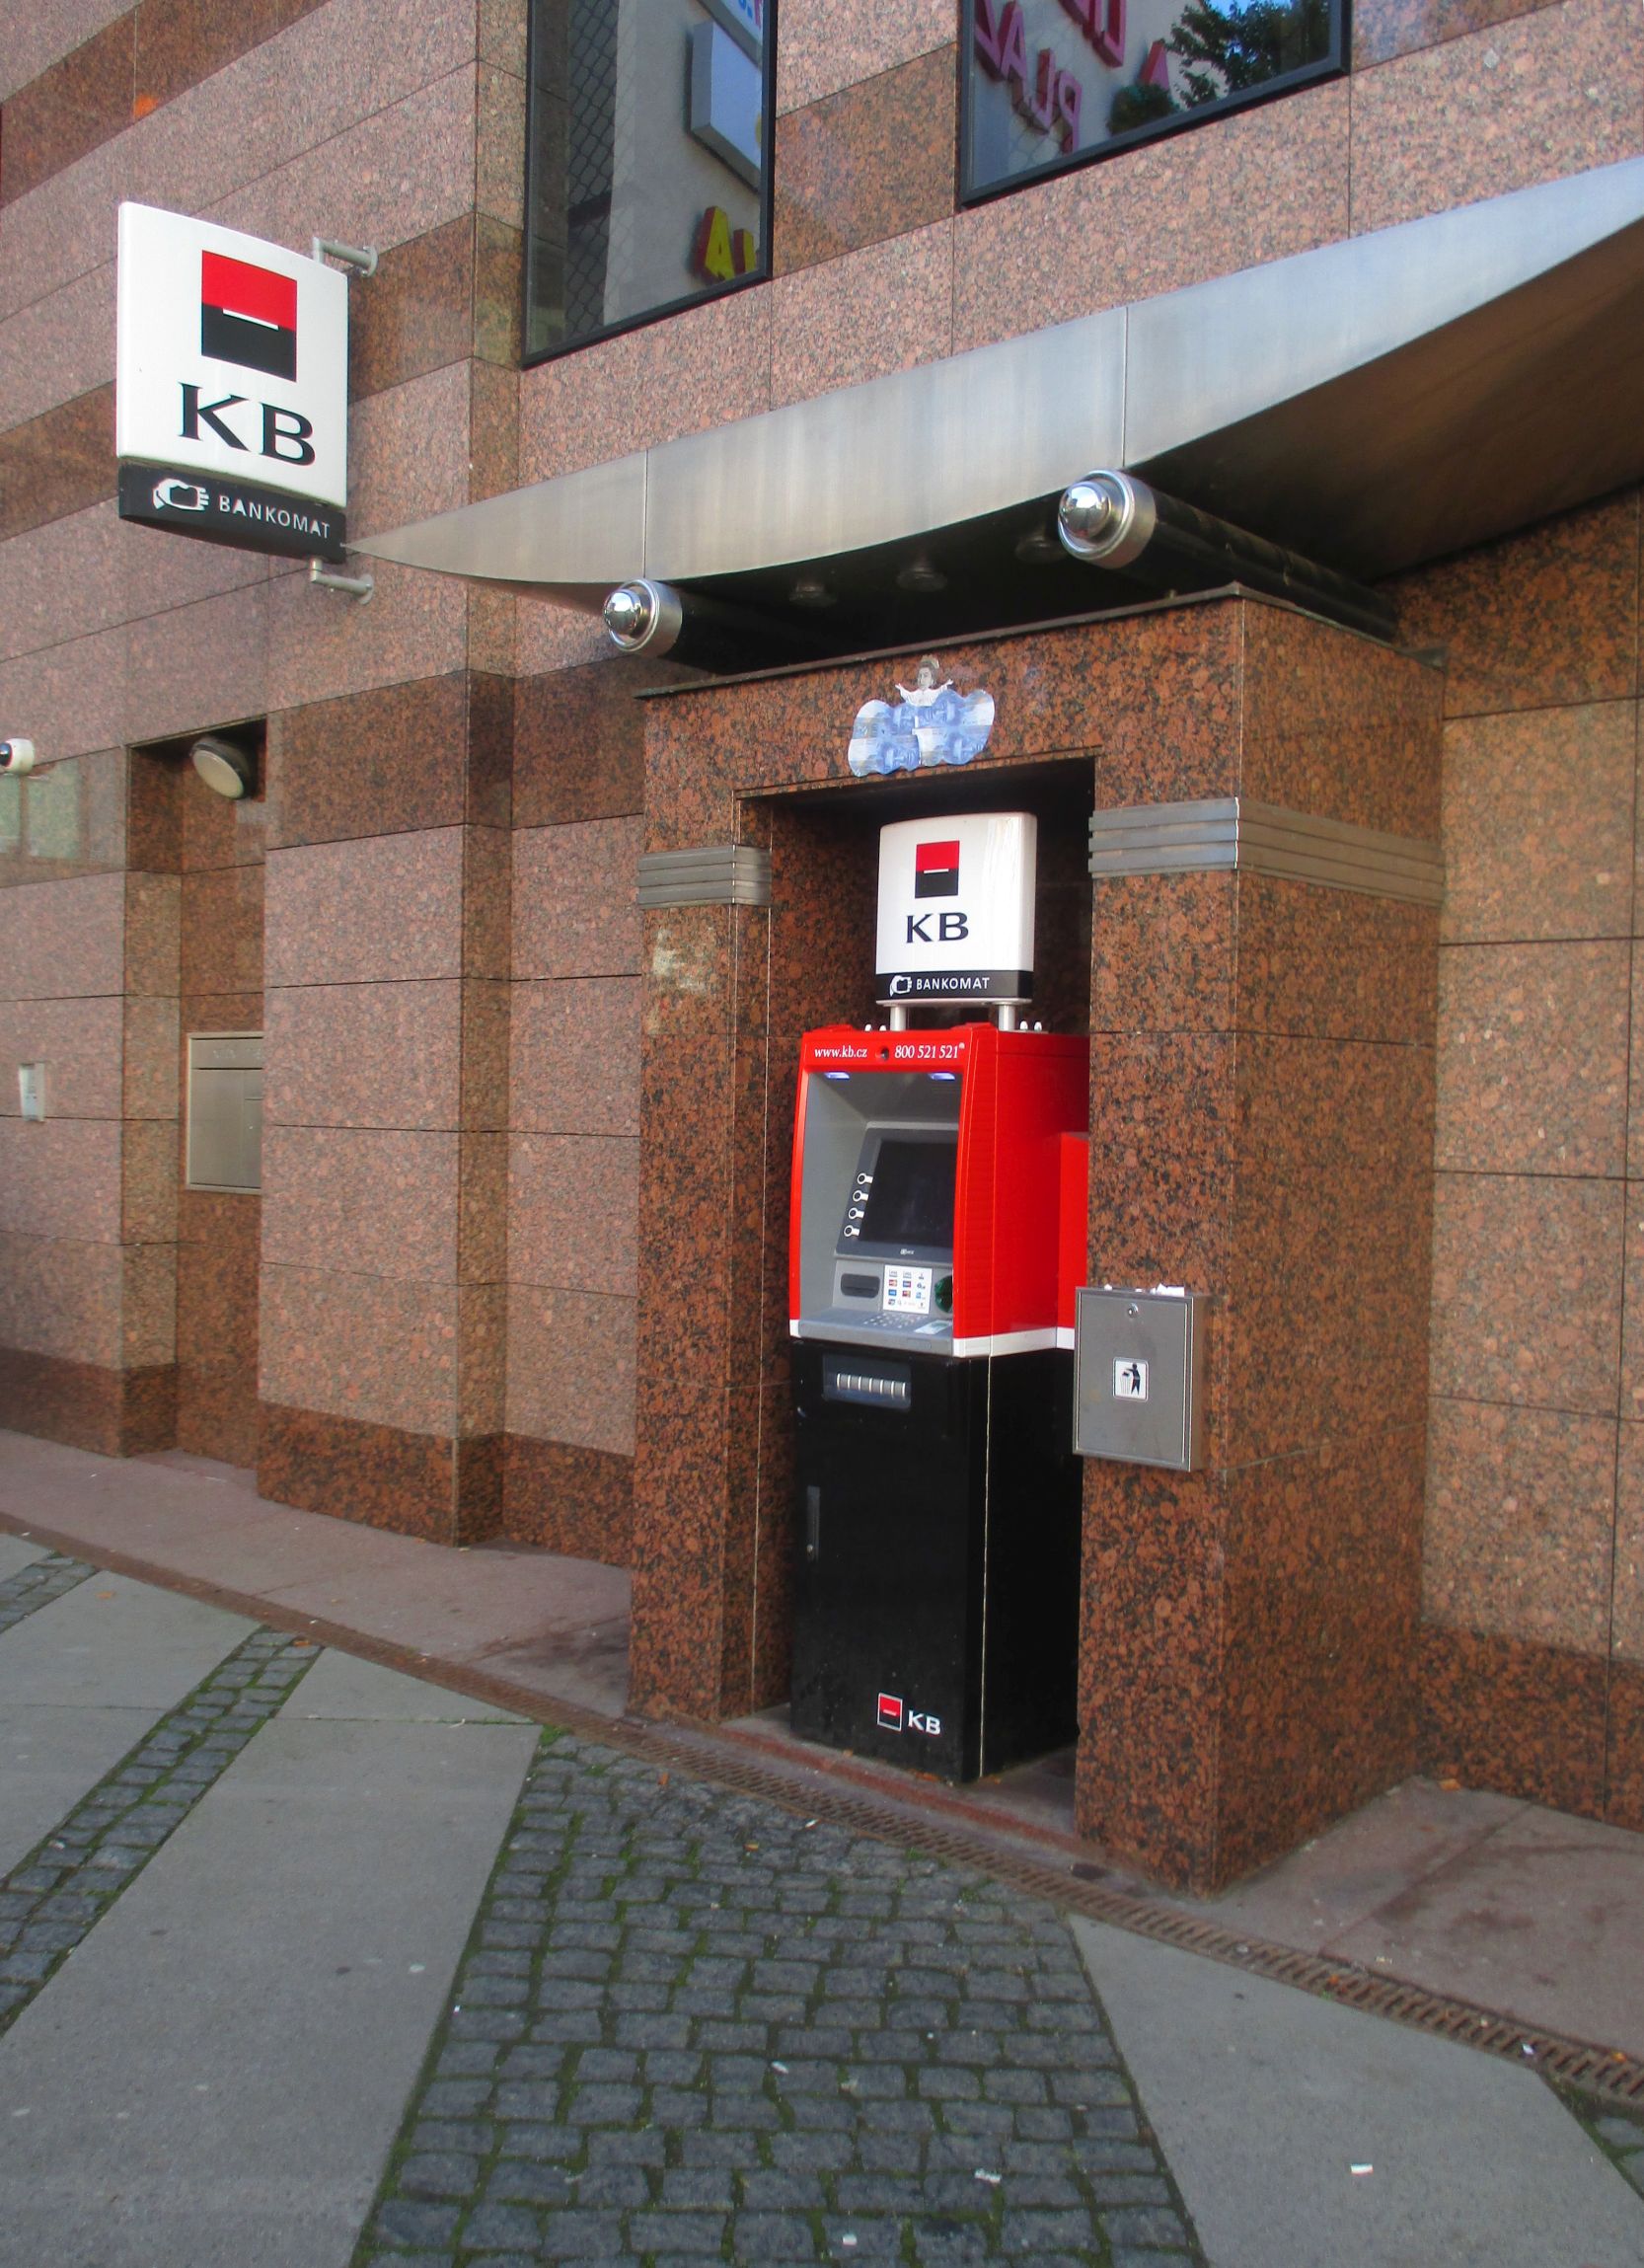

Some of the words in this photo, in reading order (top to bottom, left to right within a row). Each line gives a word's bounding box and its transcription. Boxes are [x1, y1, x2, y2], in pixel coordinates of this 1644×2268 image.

[178, 382, 316, 466] KB
[219, 494, 331, 539] BANKOMAT
[906, 912, 969, 944] KB
[916, 976, 990, 991] BANKOMAT
[814, 1045, 868, 1058] www.kb.cz
[894, 1044, 916, 1059] 800
[917, 1044, 936, 1059] 521
[938, 1044, 959, 1059] 521
[907, 1709, 941, 1735] KB
